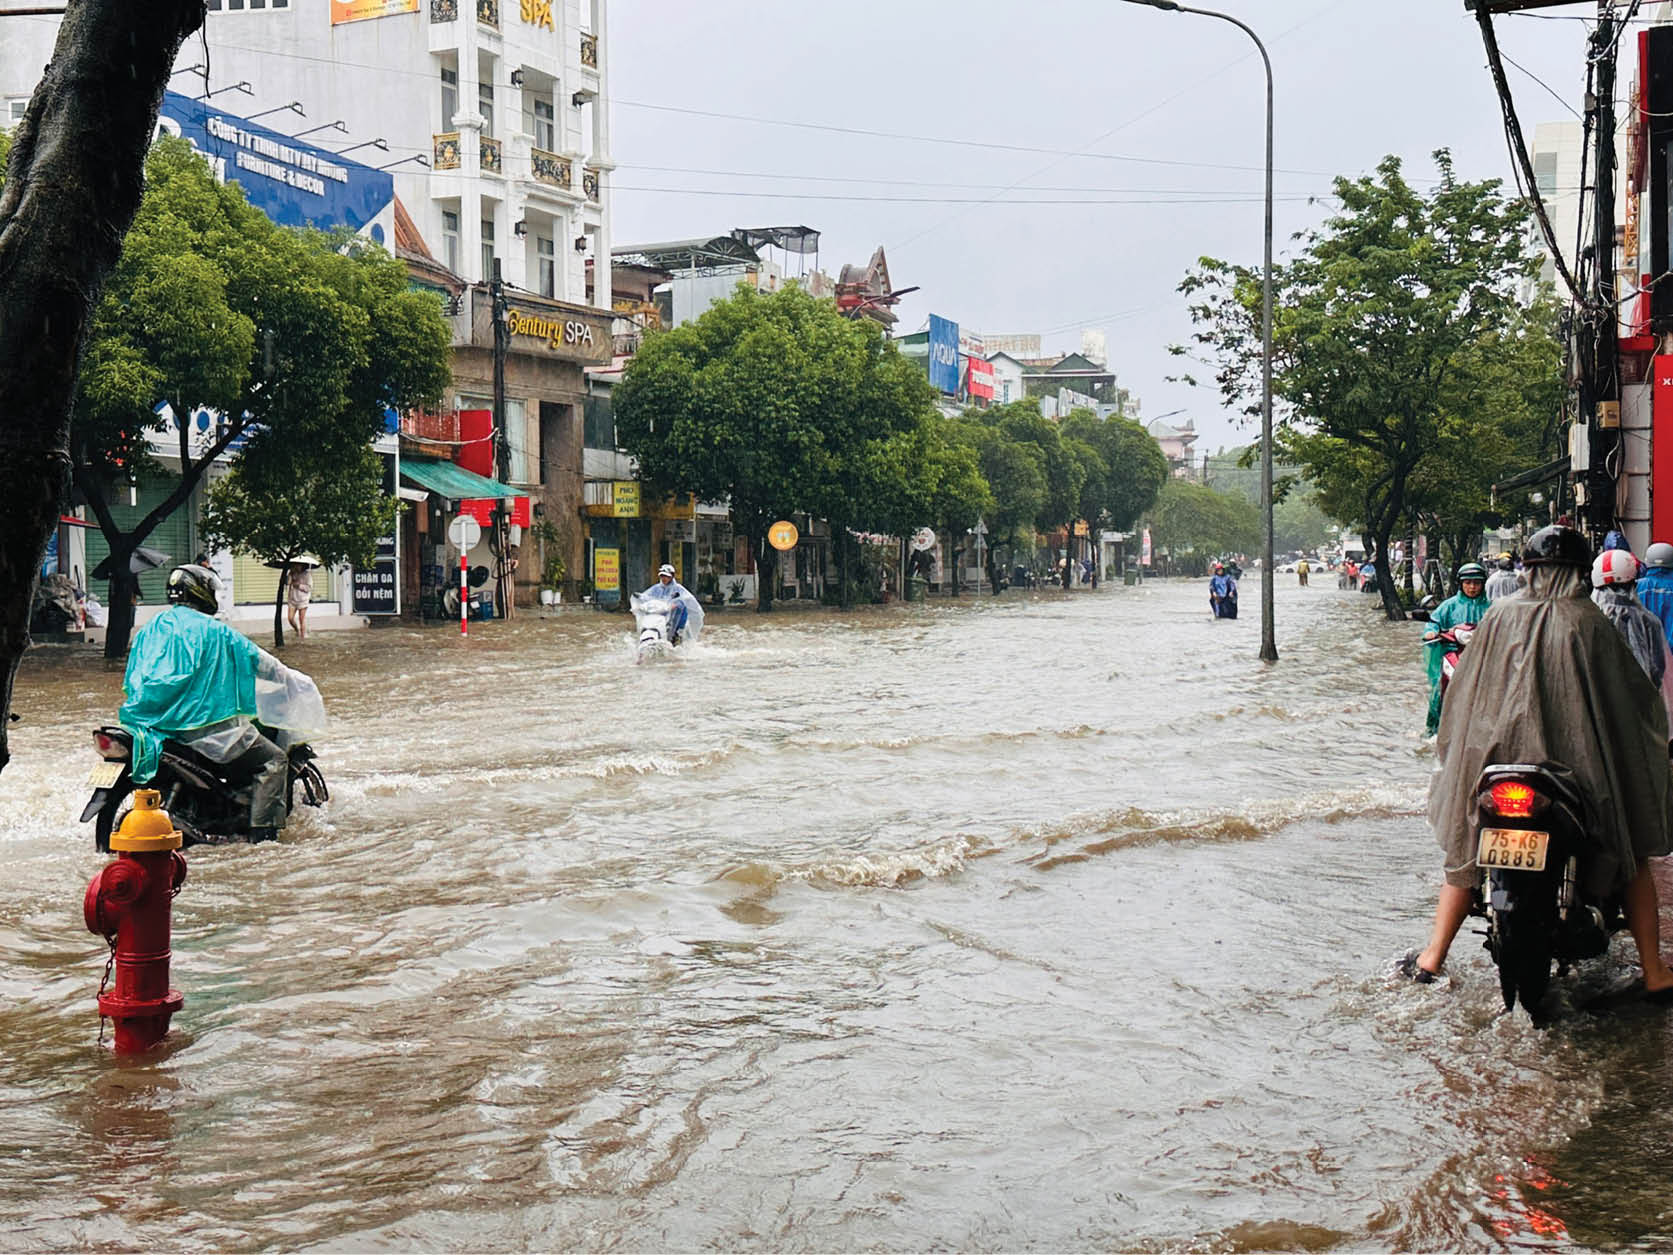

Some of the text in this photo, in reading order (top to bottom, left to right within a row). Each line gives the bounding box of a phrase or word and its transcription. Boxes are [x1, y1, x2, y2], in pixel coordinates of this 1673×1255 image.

[519, 0, 556, 33] SPA
[207, 115, 239, 144] CÔNG
[236, 151, 288, 182] FURNITURE
[287, 170, 296, 186] &
[295, 172, 325, 196] DECOR
[508, 308, 594, 348] Century SPA
[933, 342, 958, 368] AQUA
[1491, 831, 1538, 850] 75-K6
[1488, 849, 1536, 867] 0885
